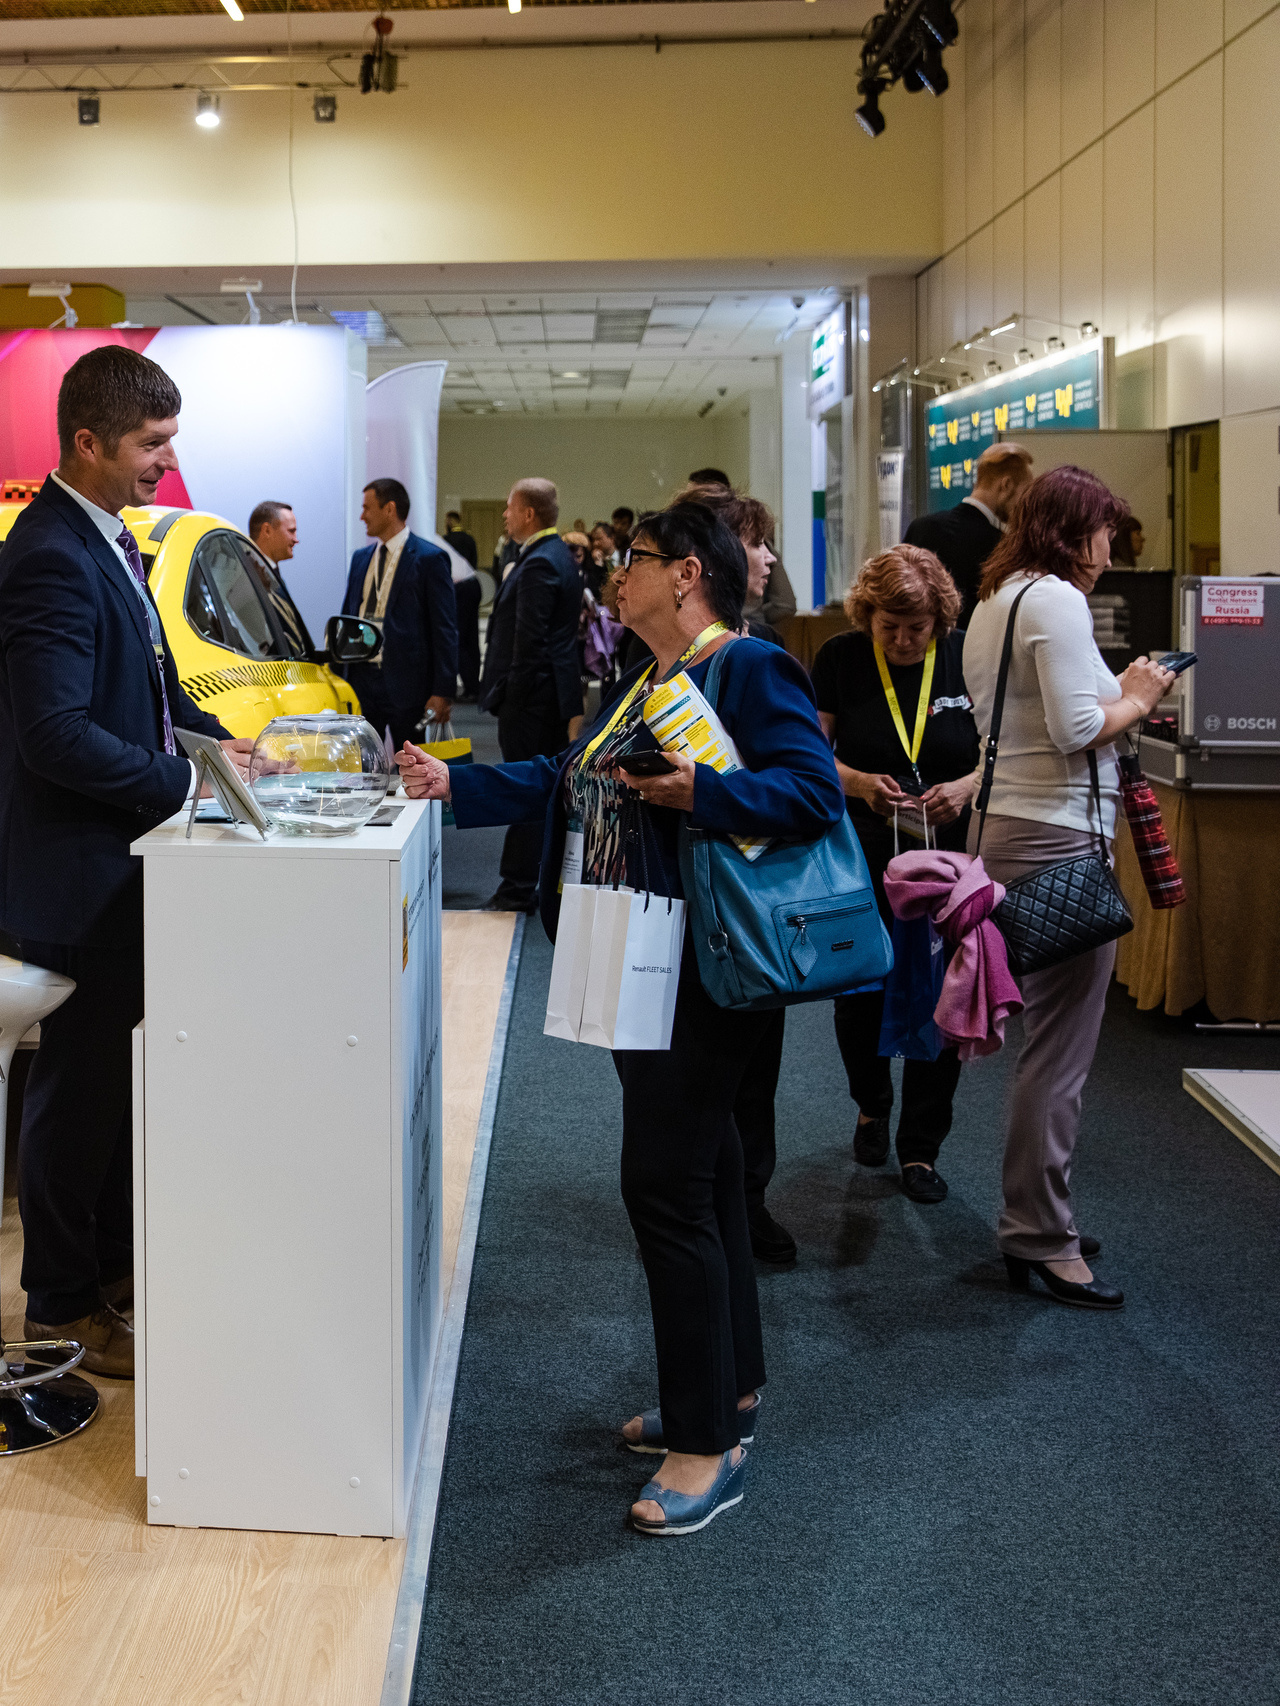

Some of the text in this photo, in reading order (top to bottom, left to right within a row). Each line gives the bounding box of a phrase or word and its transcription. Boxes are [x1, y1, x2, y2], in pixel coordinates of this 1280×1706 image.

[1207, 587, 1258, 597] Congress
[1215, 605, 1250, 615] Russia
[1227, 717, 1277, 730] BOSCH
